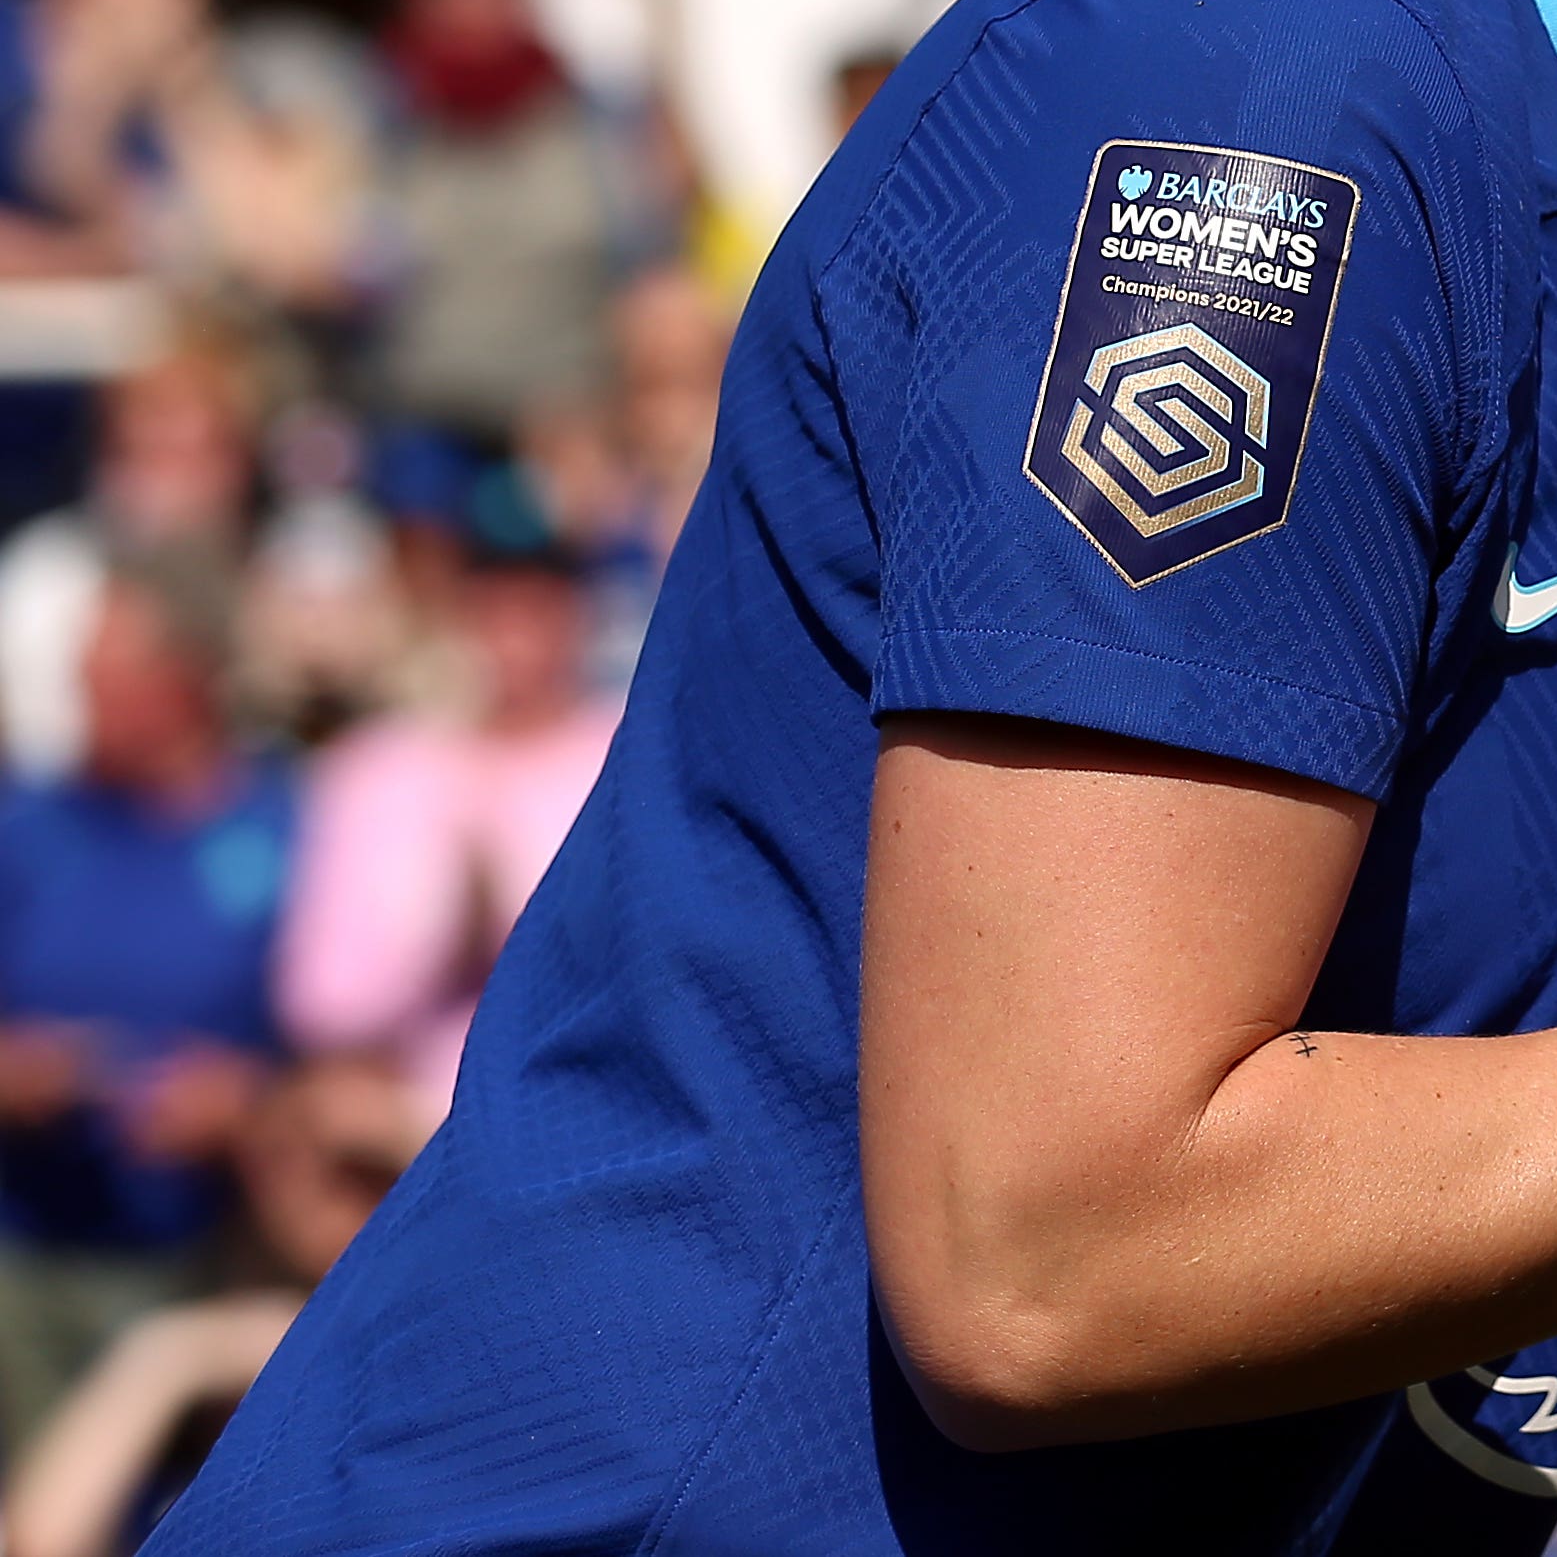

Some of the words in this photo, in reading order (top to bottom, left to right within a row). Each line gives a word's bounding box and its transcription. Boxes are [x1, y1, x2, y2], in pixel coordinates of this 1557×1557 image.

[1156, 172, 1328, 229] BARCLAYS
[1110, 202, 1318, 268] WOMEN'S
[1100, 236, 1195, 270] SUPER
[1196, 248, 1314, 295] LEAGUE
[1101, 275, 1210, 308] Champions
[1212, 292, 1295, 327] 2021/22
